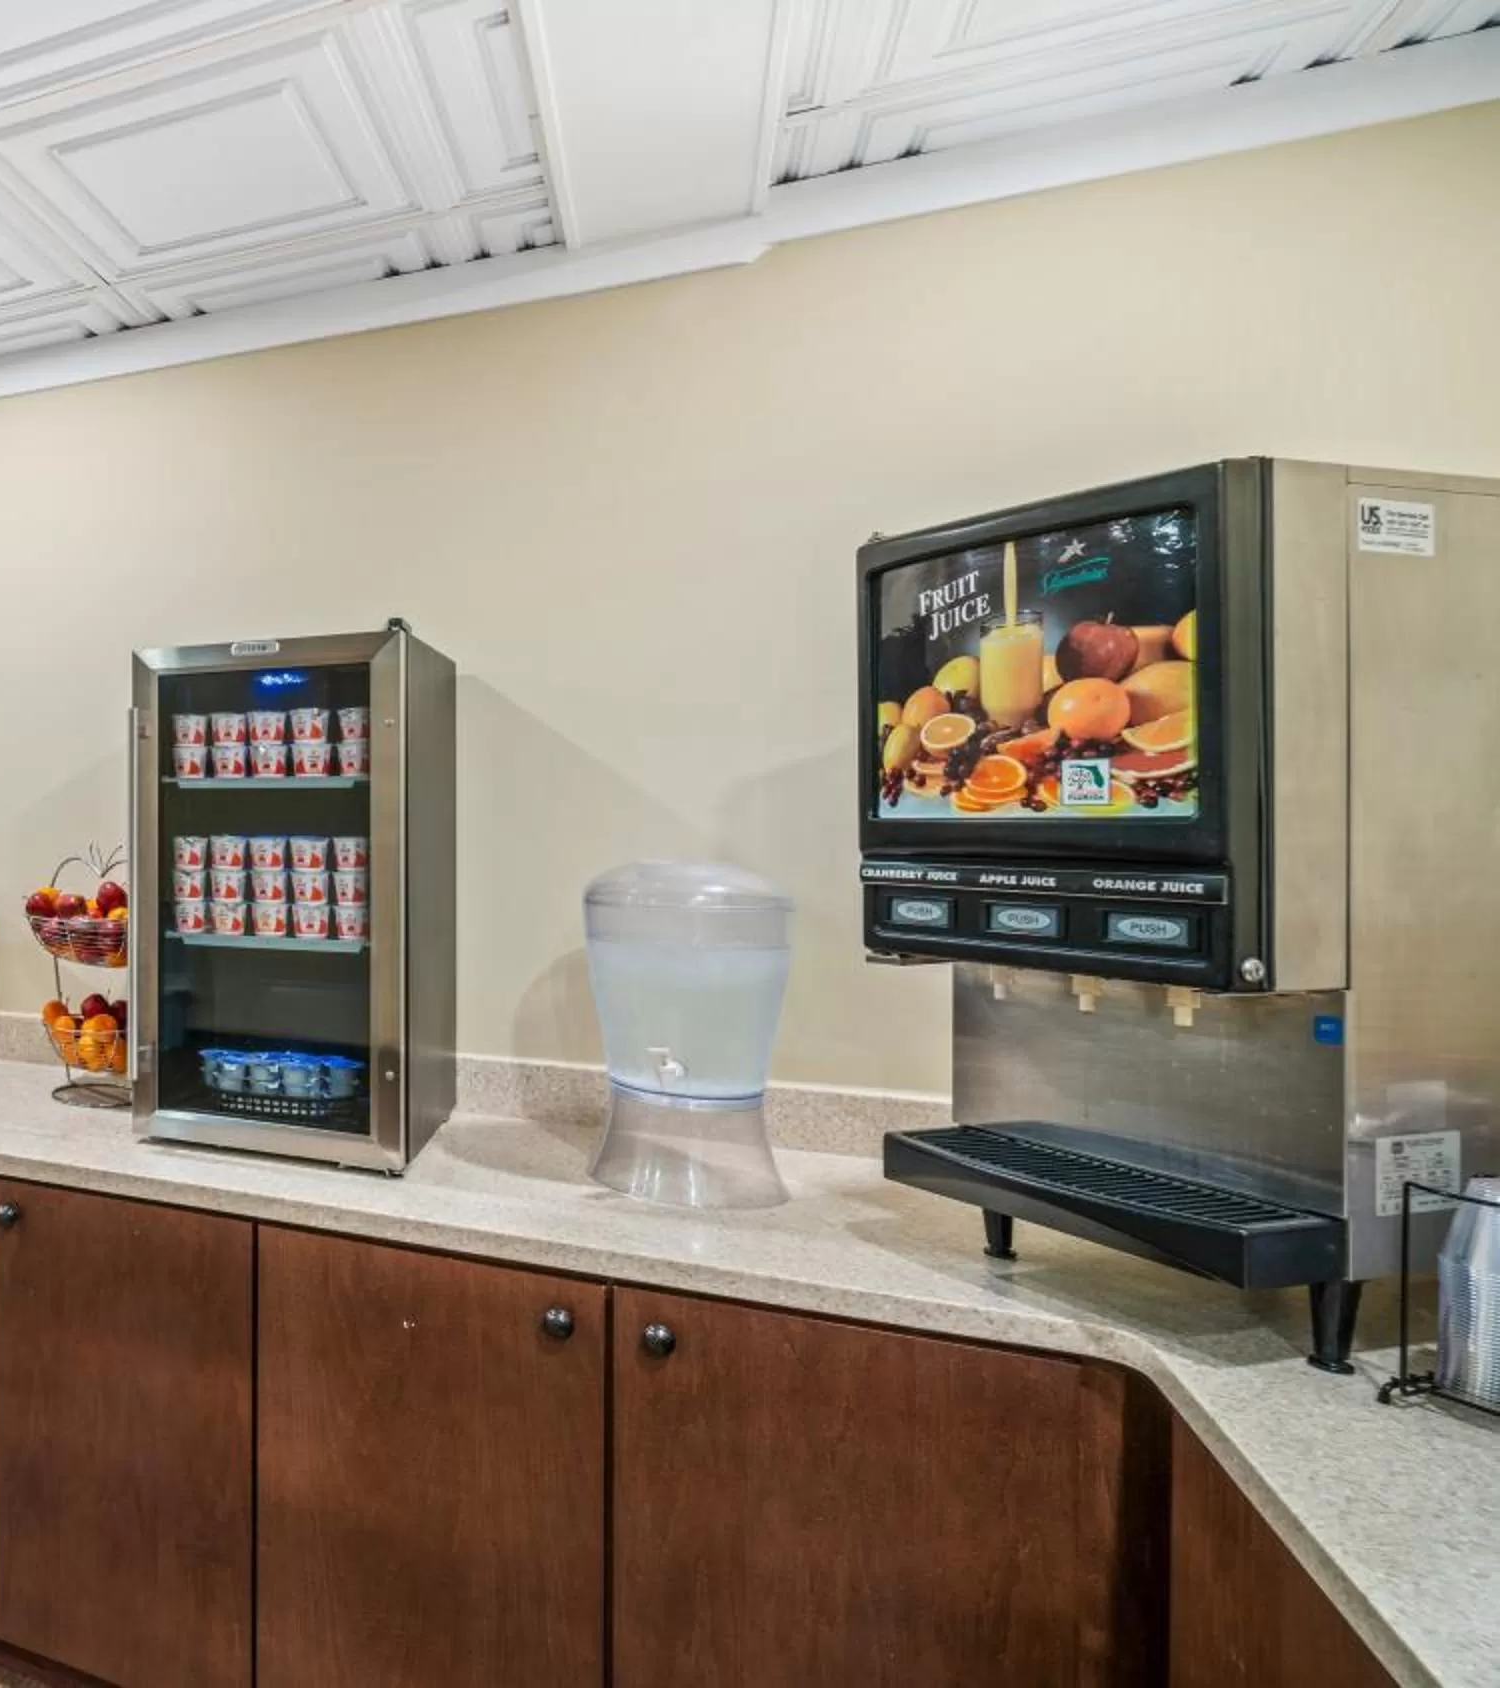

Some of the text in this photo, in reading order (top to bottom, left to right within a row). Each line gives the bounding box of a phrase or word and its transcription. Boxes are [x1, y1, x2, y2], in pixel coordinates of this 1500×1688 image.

[918, 570, 980, 617] FRUIT
[929, 593, 991, 641] JUICE
[861, 868, 958, 881] CRANBERRY JUICE
[980, 874, 1057, 888] APPLE JUICE
[1092, 879, 1204, 895] ORANGE JUICE
[1007, 913, 1041, 926] PUSH
[1129, 922, 1168, 936] PUSH
